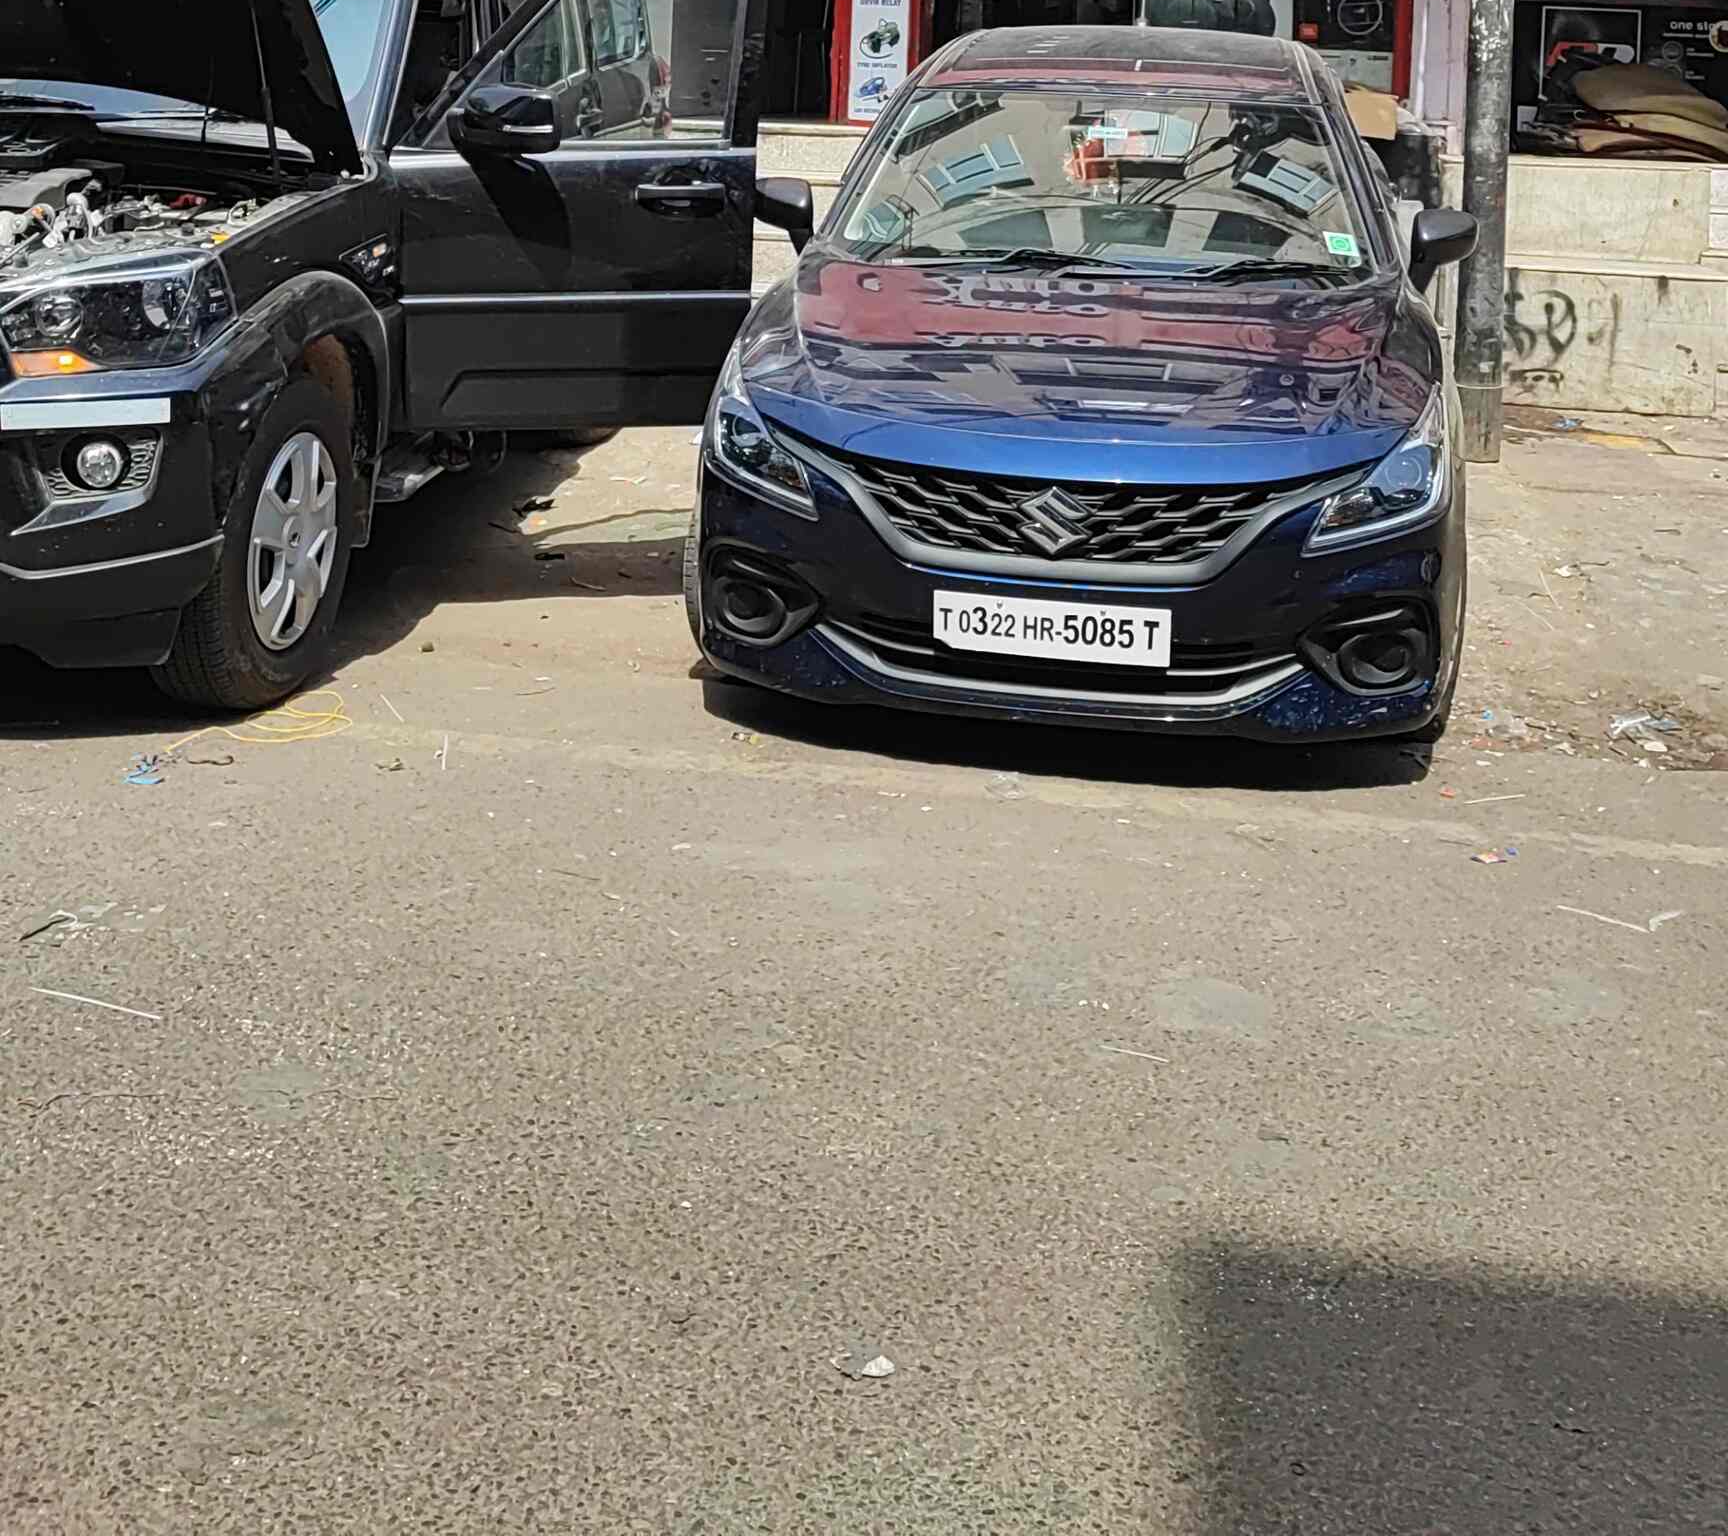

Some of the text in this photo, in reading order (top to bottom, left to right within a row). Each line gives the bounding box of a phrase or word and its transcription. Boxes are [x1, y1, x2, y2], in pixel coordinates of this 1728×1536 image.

[1670, 20, 1693, 30] one
[939, 607, 953, 632] T
[1143, 620, 1160, 650] T
